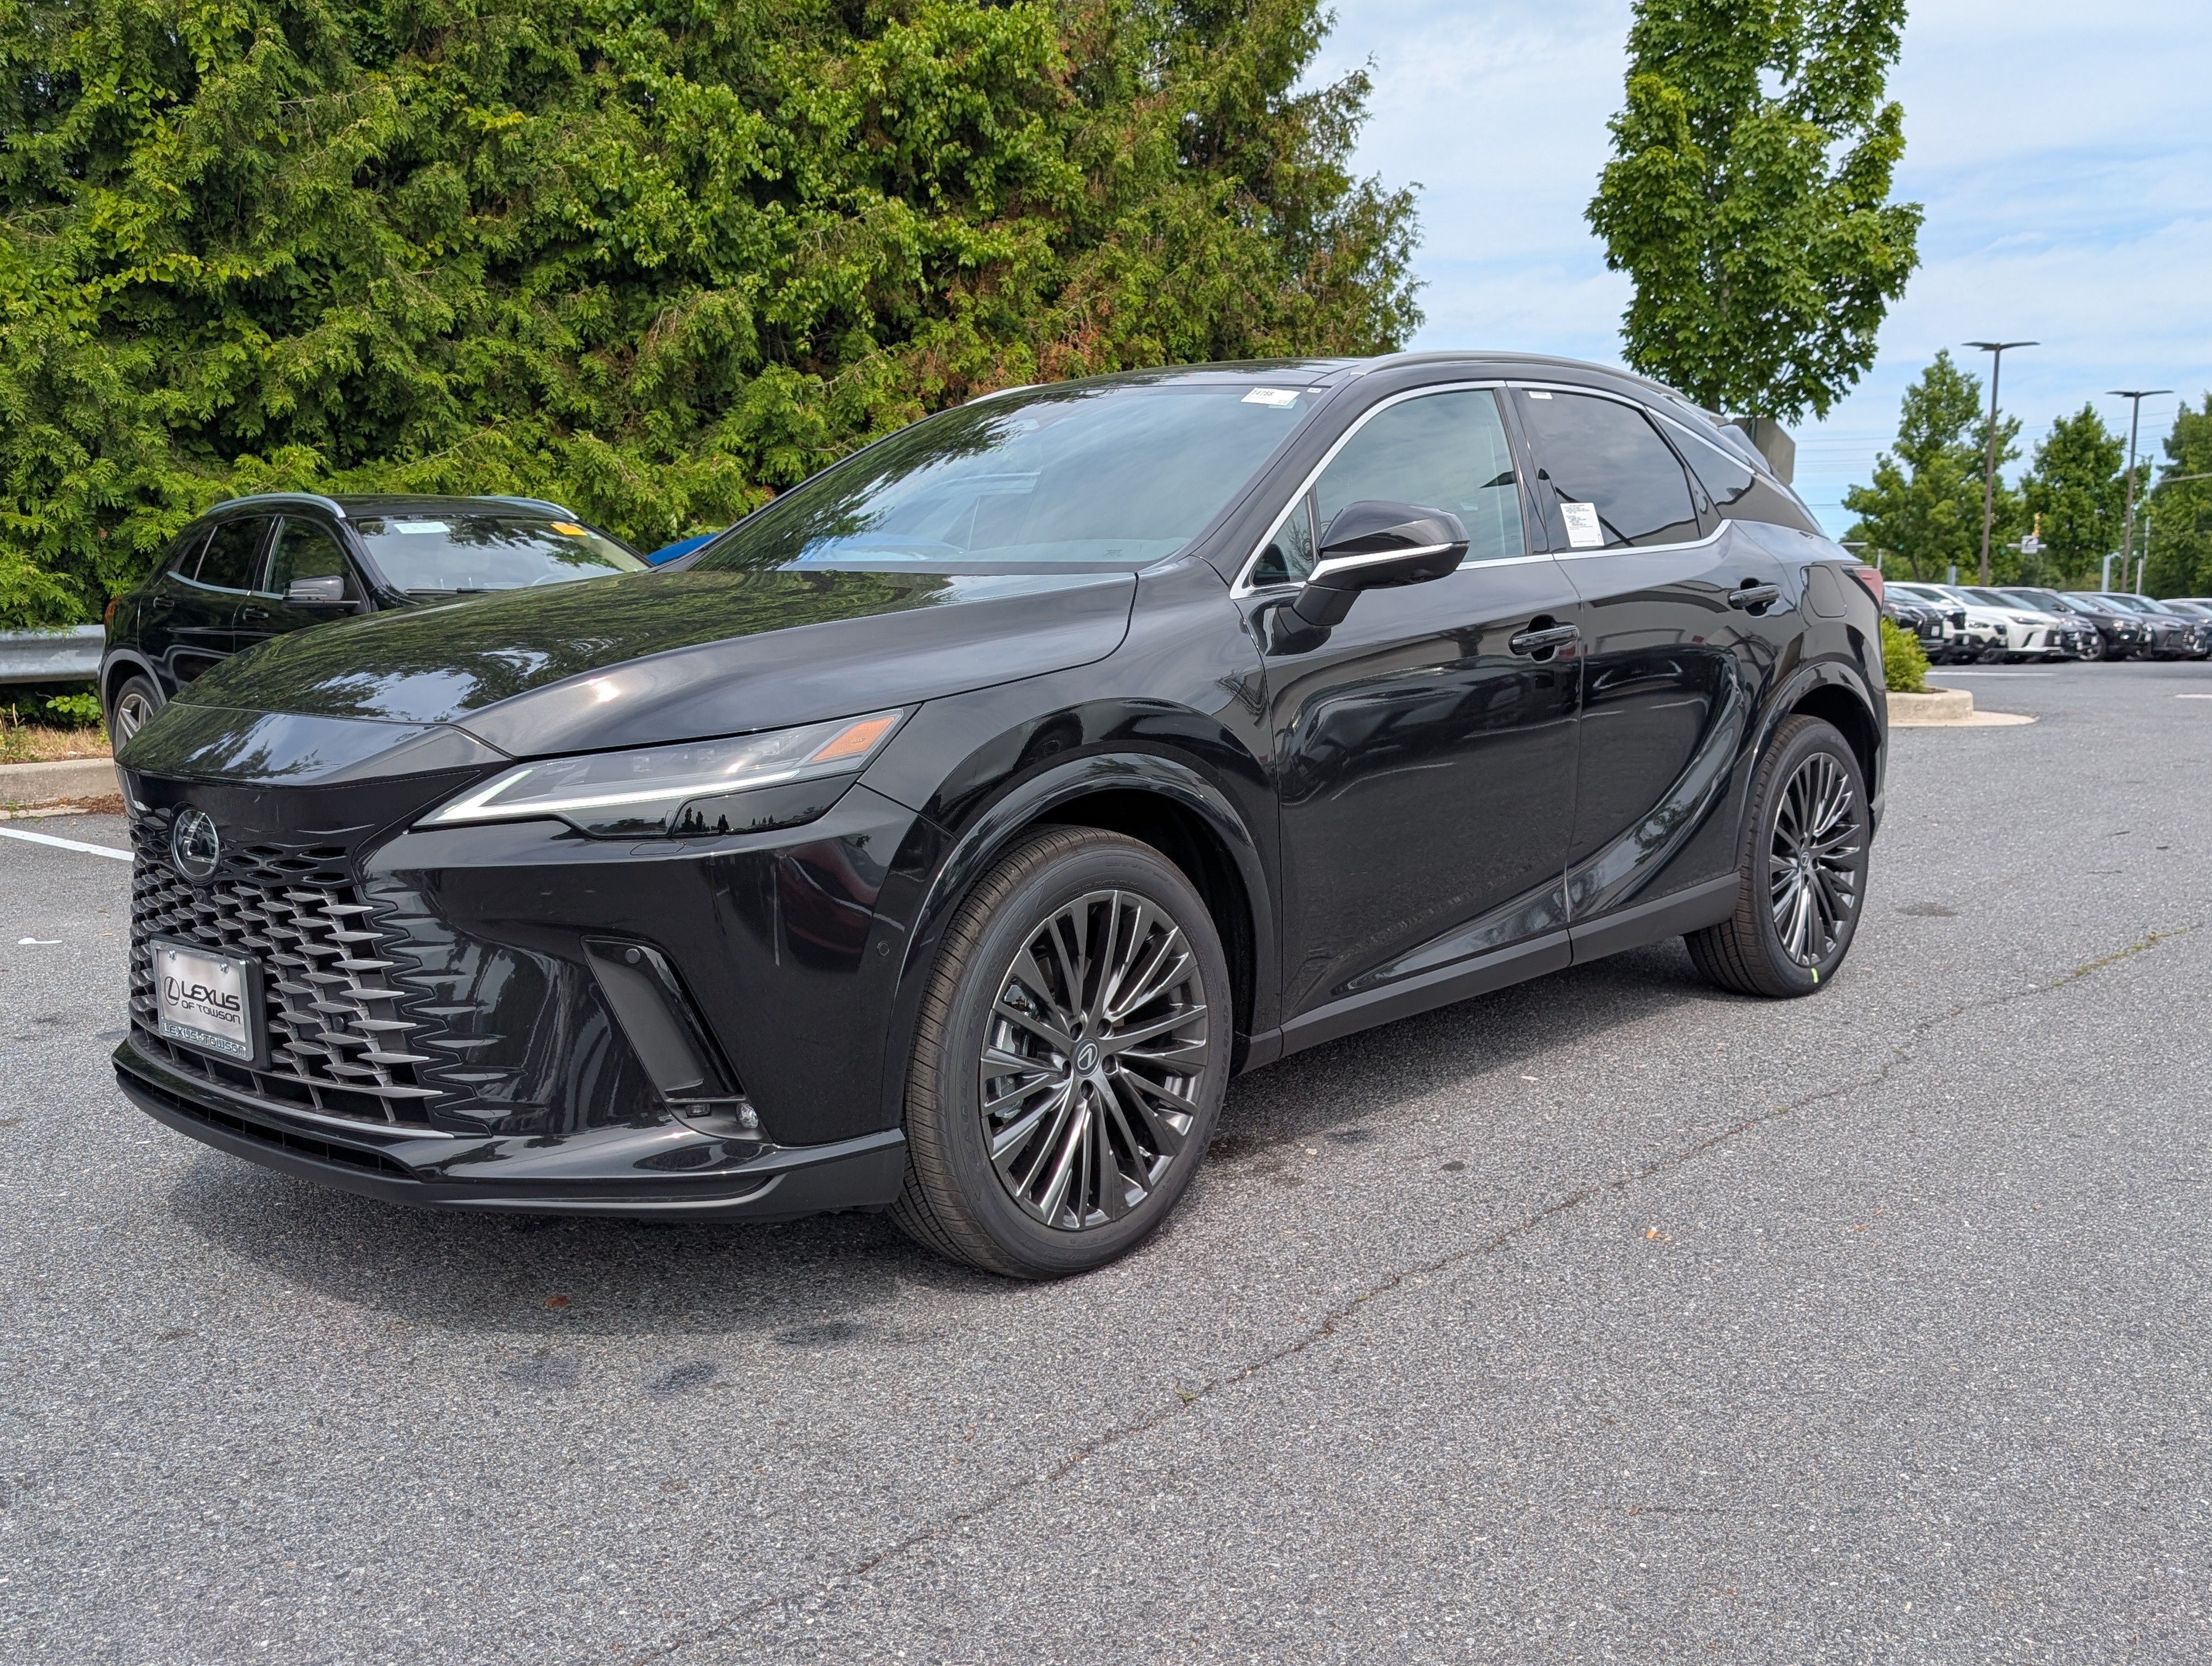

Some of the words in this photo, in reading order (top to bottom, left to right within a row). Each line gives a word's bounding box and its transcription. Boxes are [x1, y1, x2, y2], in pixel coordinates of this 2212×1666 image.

[182, 981, 240, 1011] LEXUS
[182, 1000, 195, 1010] OF
[196, 1004, 241, 1024] TOWSON
[163, 1022, 198, 1041] LEXUS
